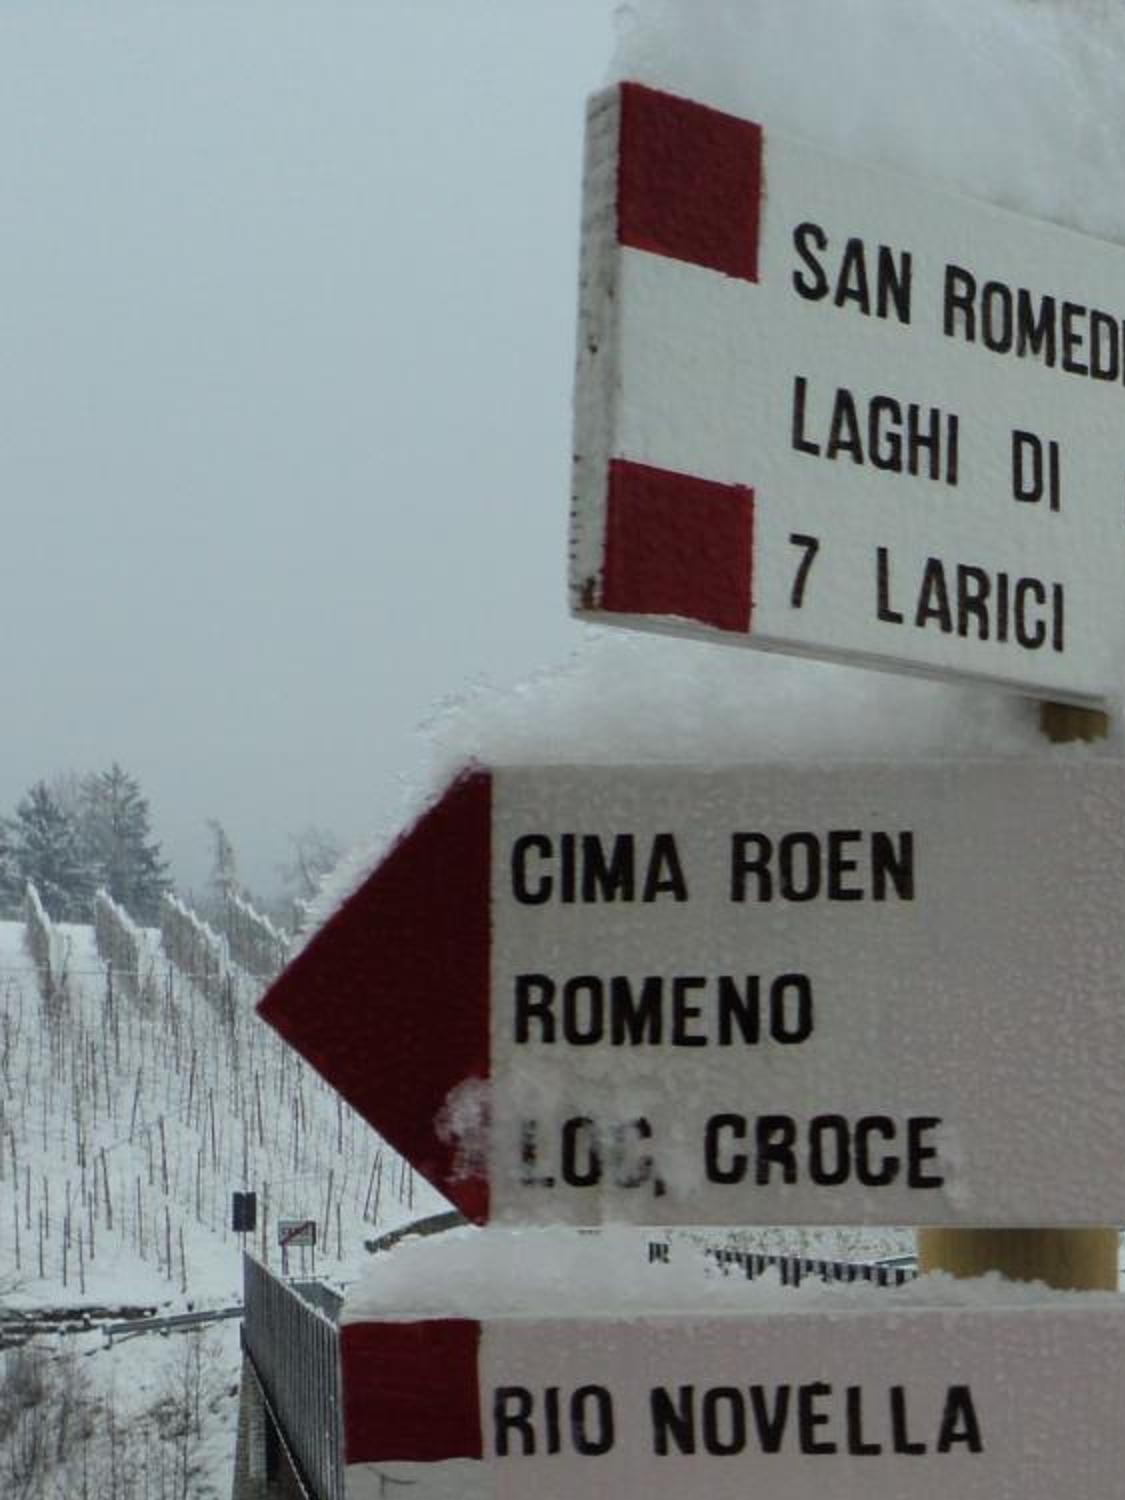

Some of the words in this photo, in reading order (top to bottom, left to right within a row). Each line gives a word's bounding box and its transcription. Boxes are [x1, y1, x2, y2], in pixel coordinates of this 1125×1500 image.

[793, 222, 912, 325] SAN
[792, 376, 959, 487] LAGHI
[1012, 429, 1060, 513] DI
[790, 533, 820, 609] 7
[876, 546, 1064, 653] LARICI
[510, 832, 689, 906] CIMA
[730, 829, 915, 903] ROEN
[514, 972, 814, 1048] ROMENO
[704, 1113, 945, 1190] CROCE
[493, 1384, 615, 1457] RIO
[650, 1381, 983, 1457] NOVELLA
